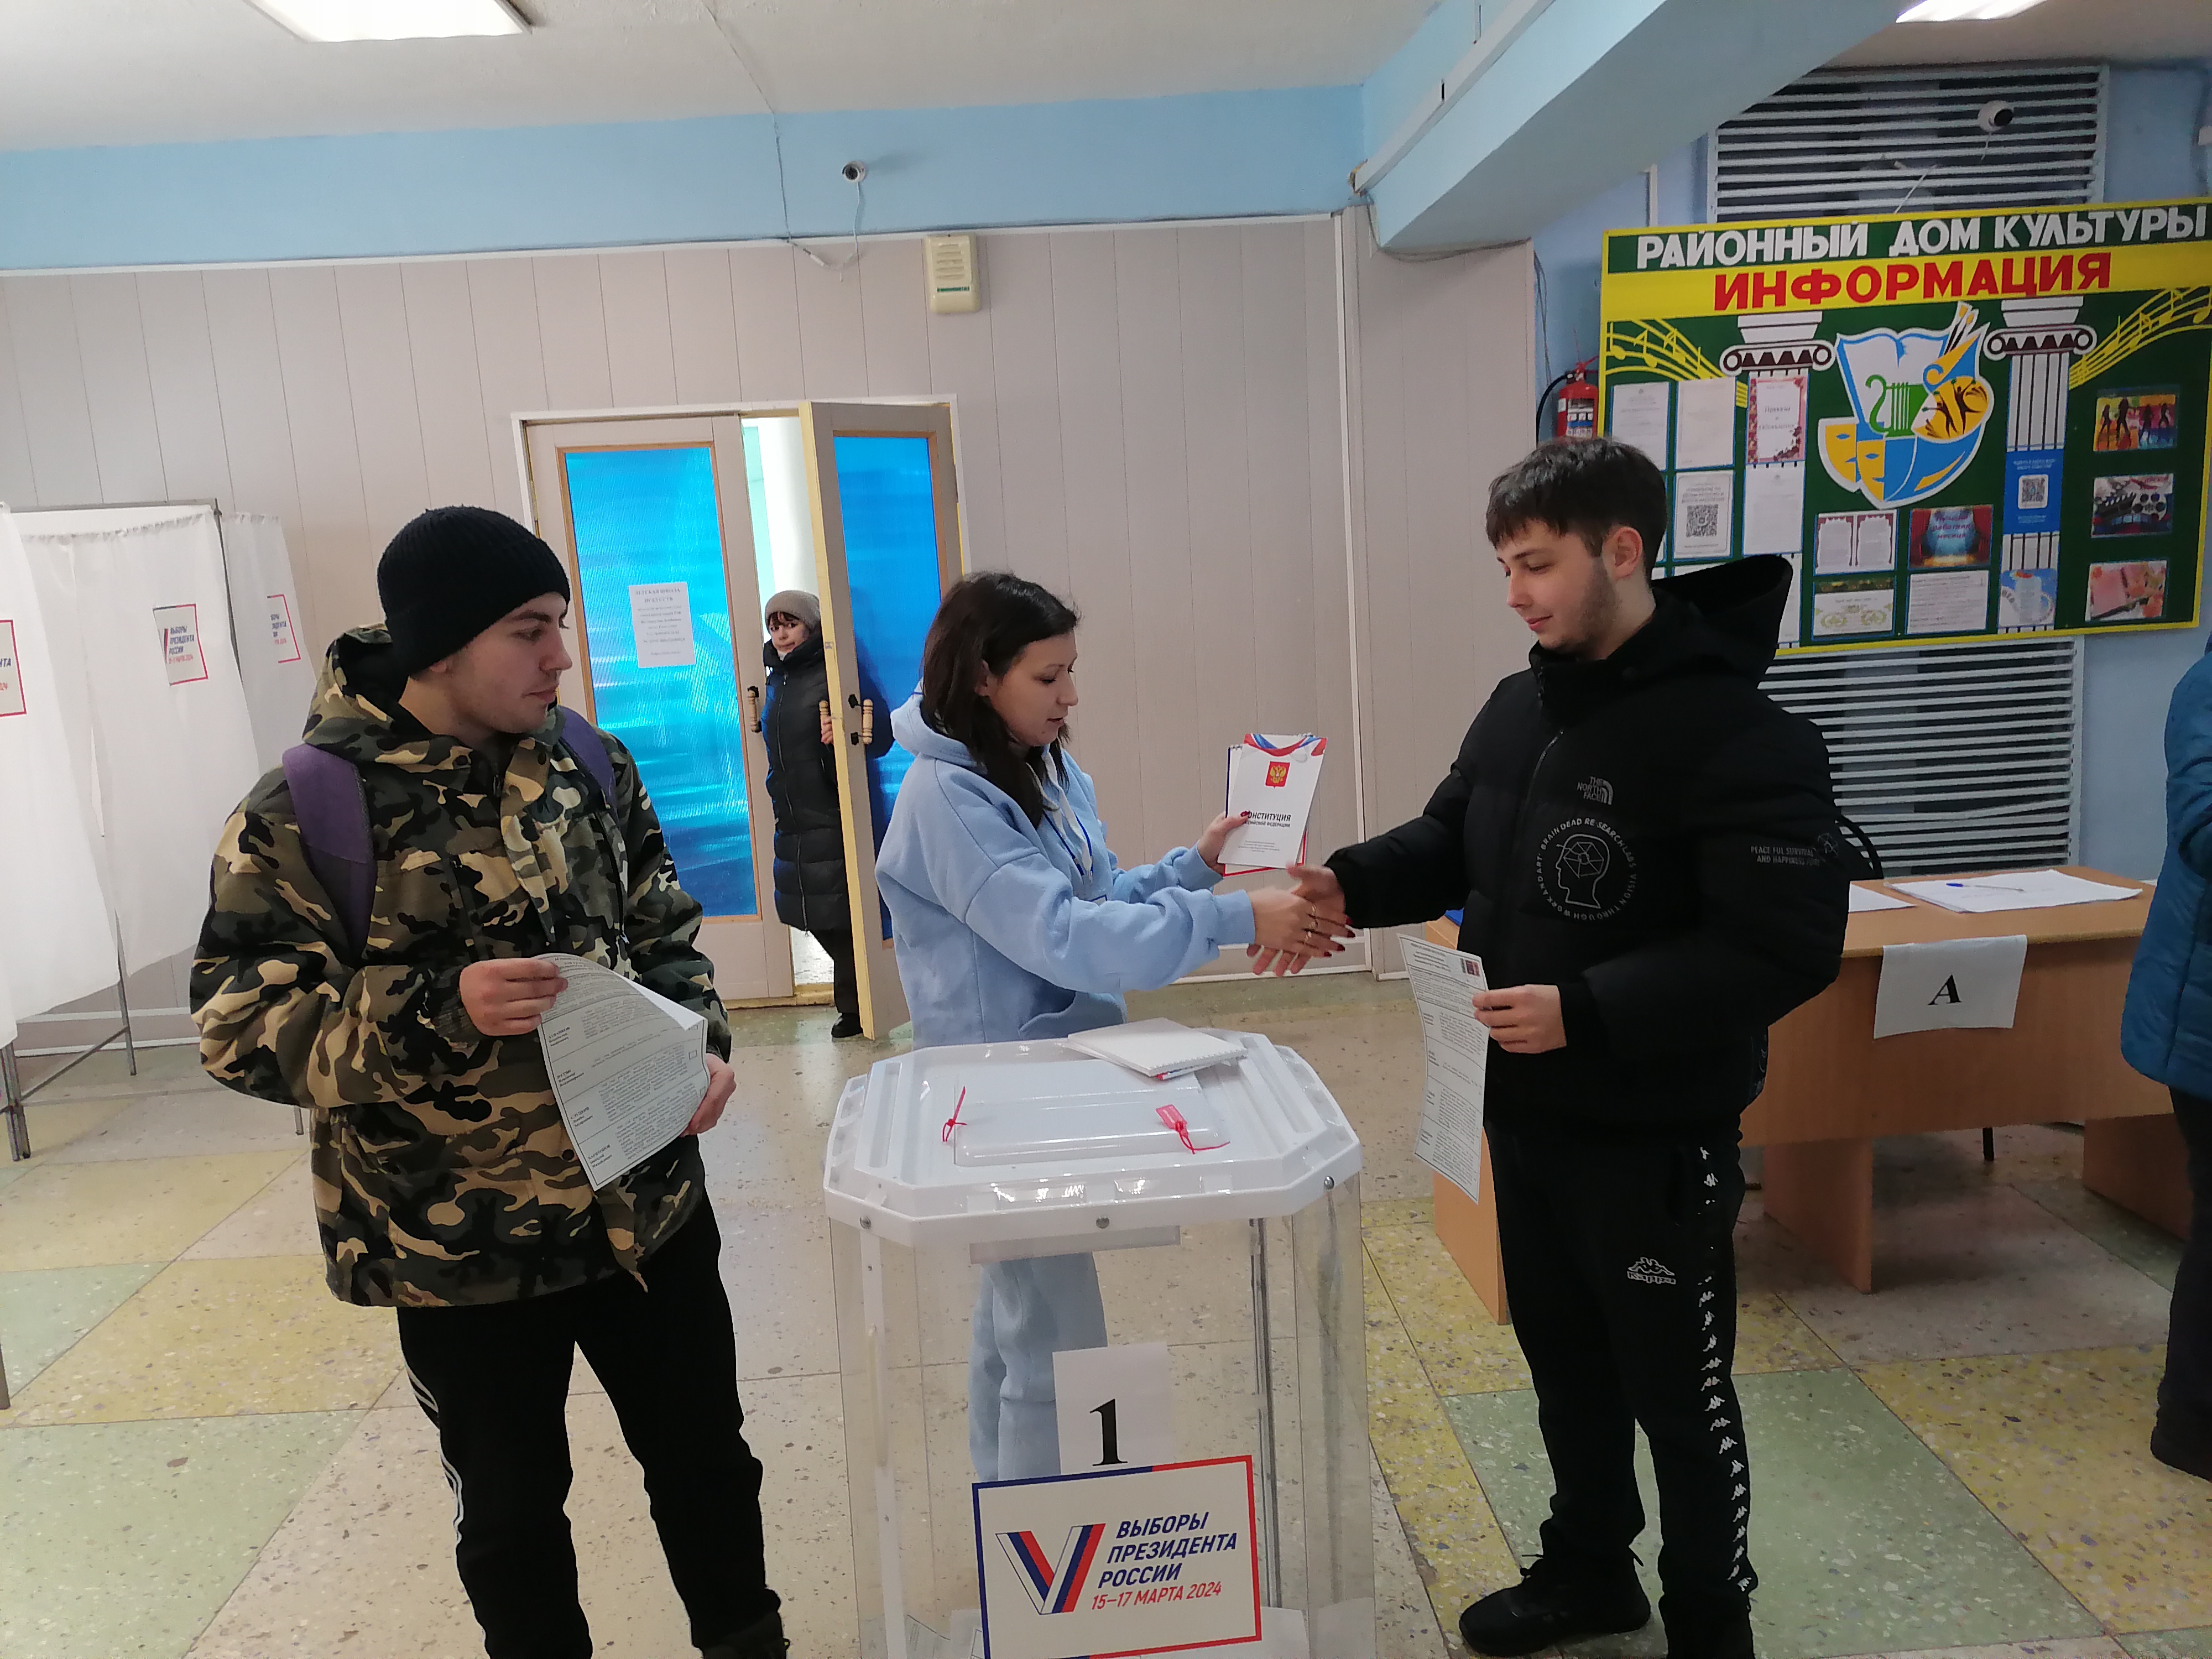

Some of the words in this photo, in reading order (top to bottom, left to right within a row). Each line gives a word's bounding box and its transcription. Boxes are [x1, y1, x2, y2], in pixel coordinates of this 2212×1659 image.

[1637, 221, 1869, 269] РАЙОННЫЙ
[1889, 217, 1981, 257] ДОМ
[1995, 205, 2207, 248] КУЛЬТУРЫ
[1714, 252, 2111, 311] ИНФОРМАЦИЯ
[1577, 781, 1602, 795] NORTH
[1589, 776, 1604, 786] THE
[1248, 811, 1291, 821] ОНСТИТУЦИЯ
[1560, 818, 1582, 831] DEAD
[1089, 1399, 1128, 1467] 1
[1116, 1511, 1210, 1540] ВЫБОРЫ
[1107, 1532, 1238, 1564] ПРЕЗИДЕНТА
[1098, 1562, 1183, 1589] РОССИИ
[1133, 1585, 1184, 1608] МАРТА
[1186, 1581, 1223, 1600] 2024
